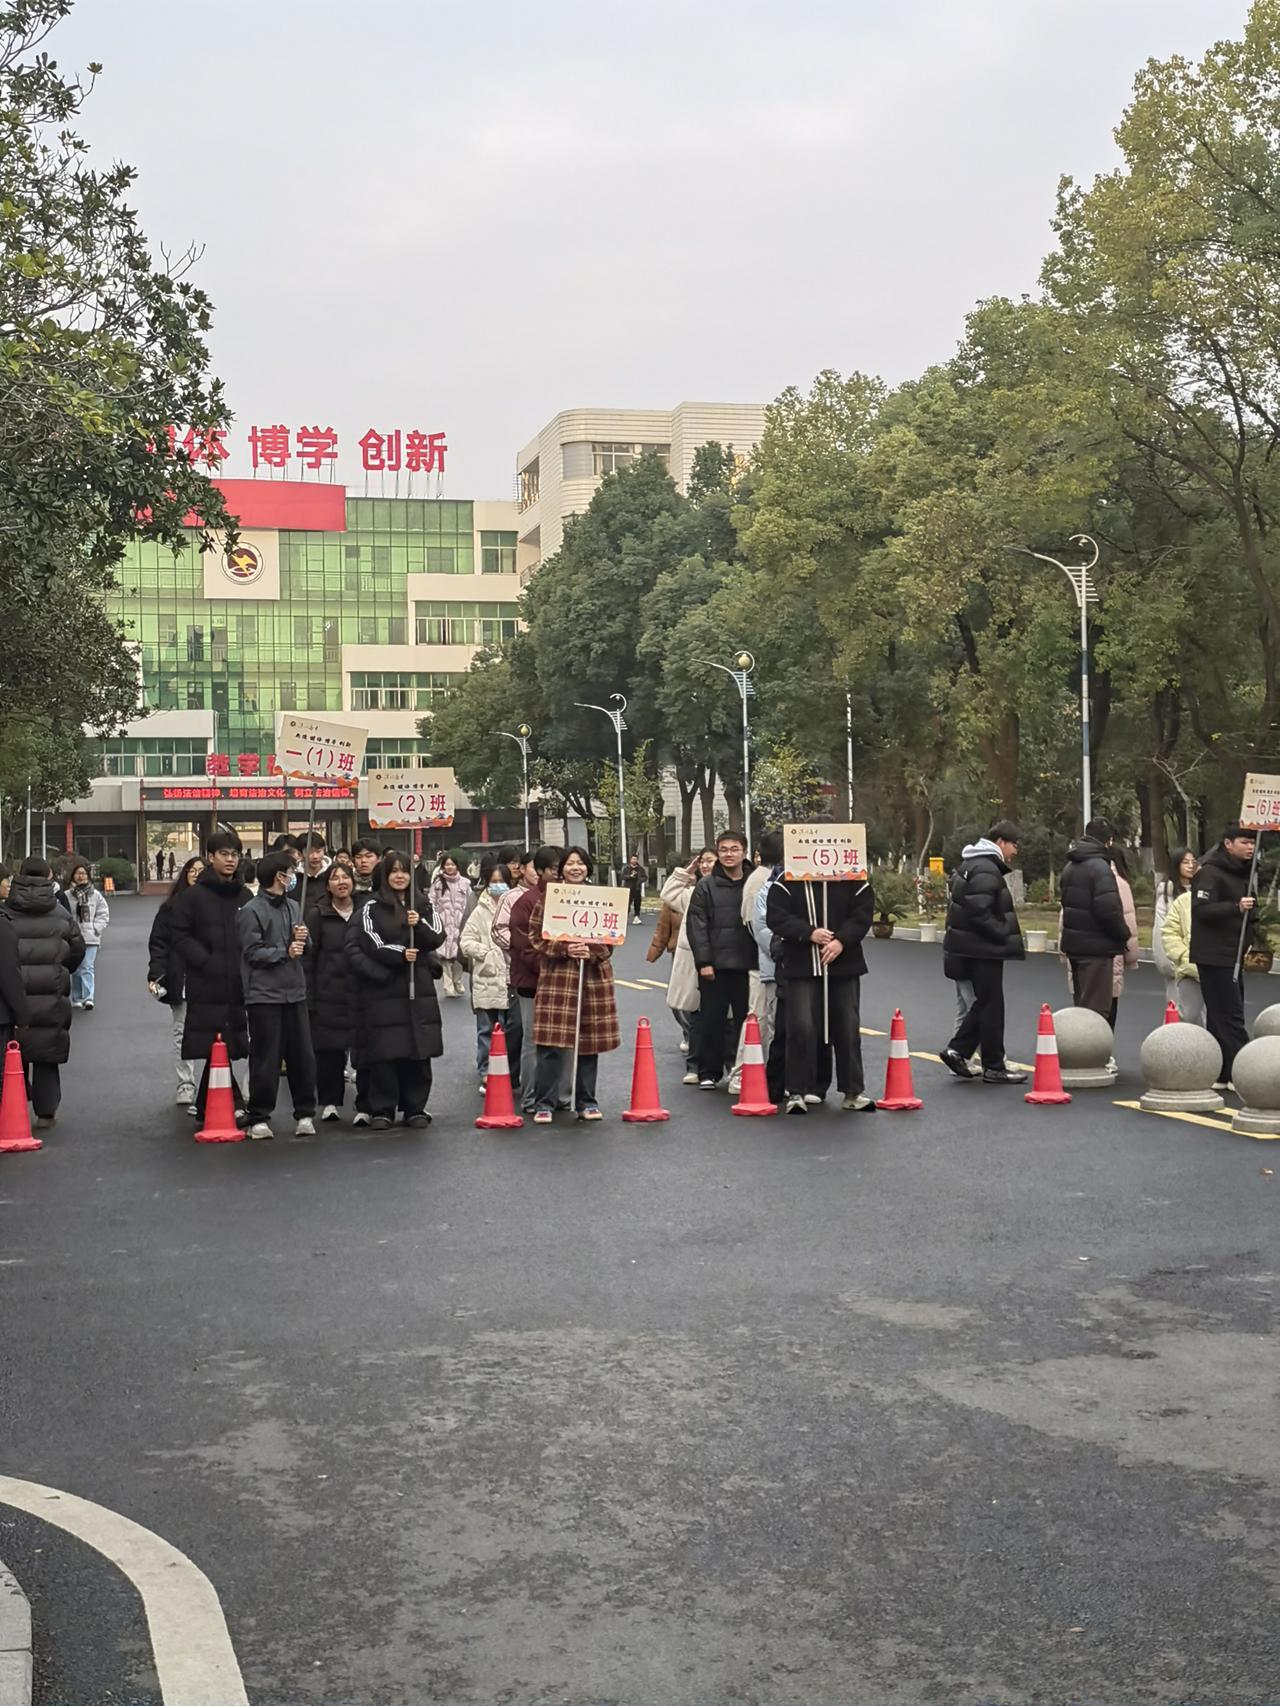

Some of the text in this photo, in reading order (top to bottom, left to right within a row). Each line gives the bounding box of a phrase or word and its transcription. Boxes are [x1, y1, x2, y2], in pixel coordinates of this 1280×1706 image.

[248, 424, 338, 469] 博学
[358, 428, 448, 473] 创新
[207, 752, 276, 776] 教学
[286, 746, 355, 771] 一(1)班
[377, 794, 446, 813] 一(2)班
[792, 849, 859, 866] 一(5)班
[552, 910, 619, 930] 一(4)班
